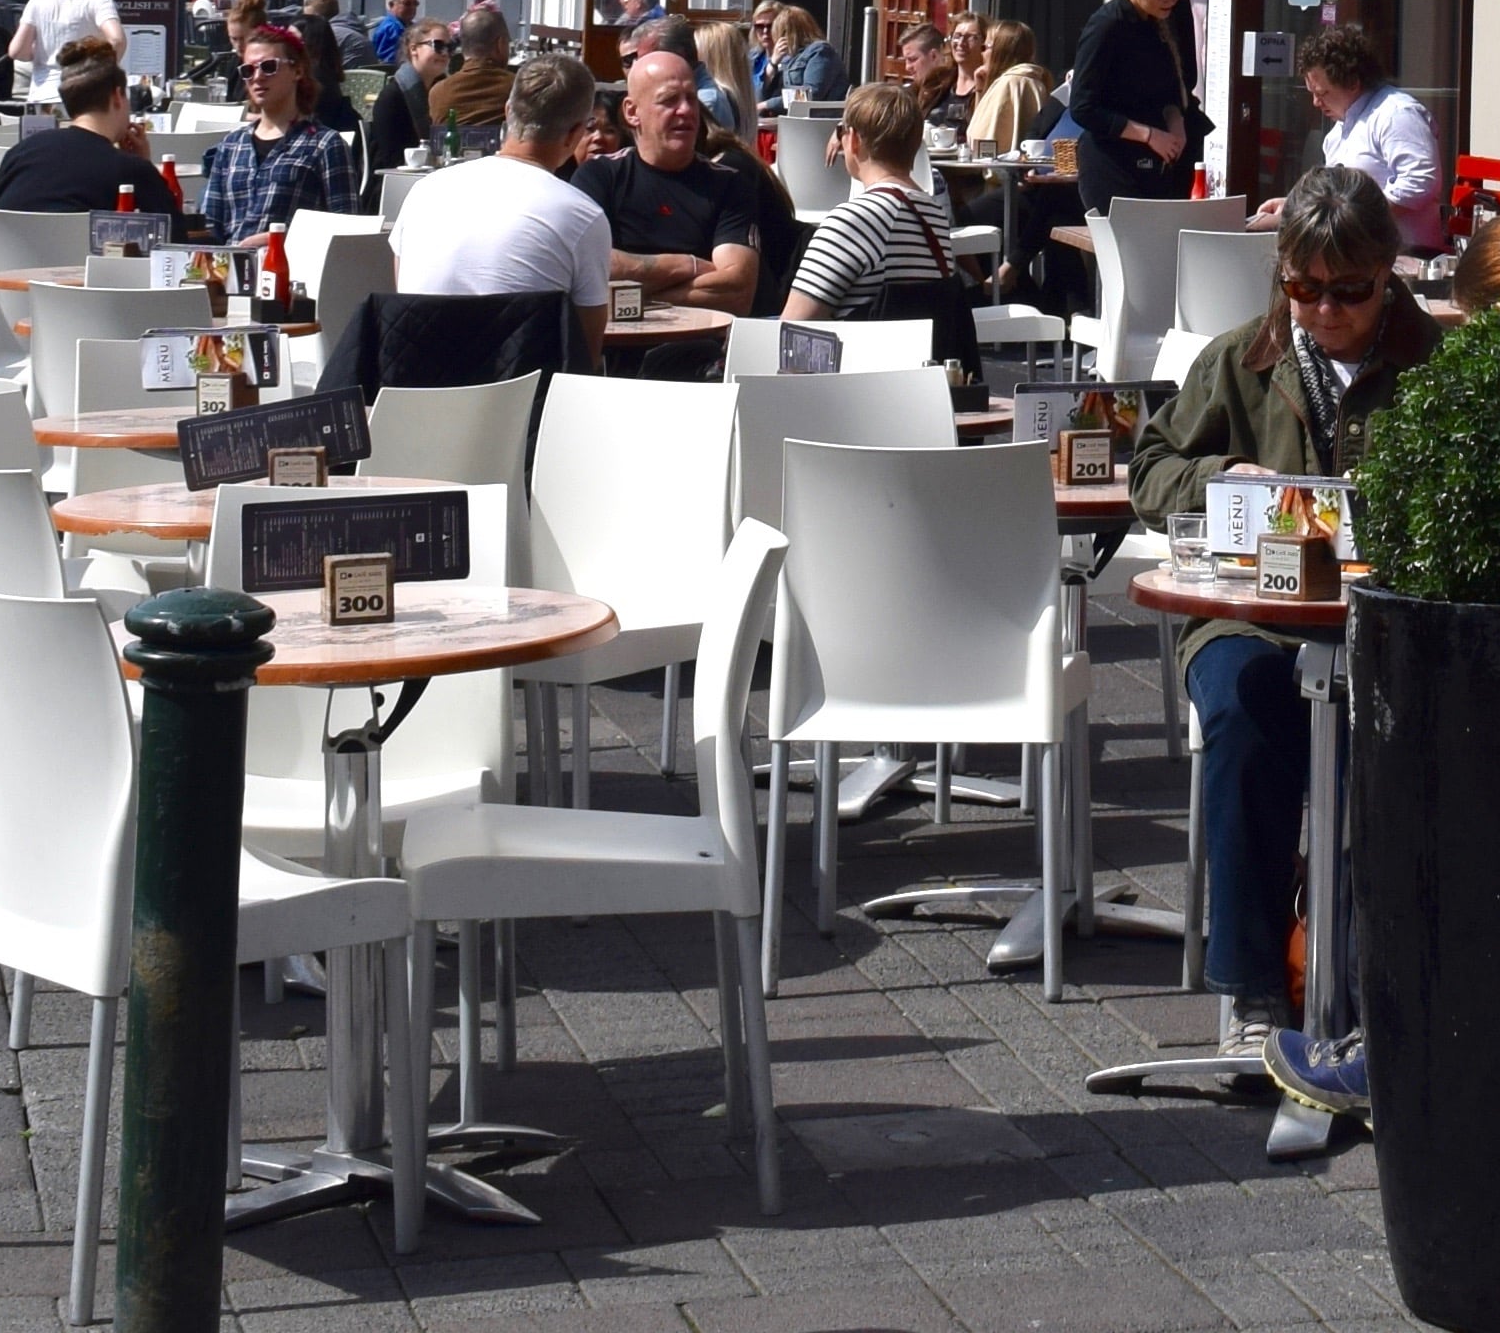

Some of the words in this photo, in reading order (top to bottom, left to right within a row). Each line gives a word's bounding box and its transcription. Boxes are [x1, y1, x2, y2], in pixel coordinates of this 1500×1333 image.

[617, 306, 639, 318] 203
[159, 344, 172, 383] MENU
[201, 401, 227, 413] 302
[1075, 462, 1108, 477] 201
[1232, 494, 1244, 546] MENU
[1263, 573, 1299, 591] 200
[338, 594, 385, 614] 300
